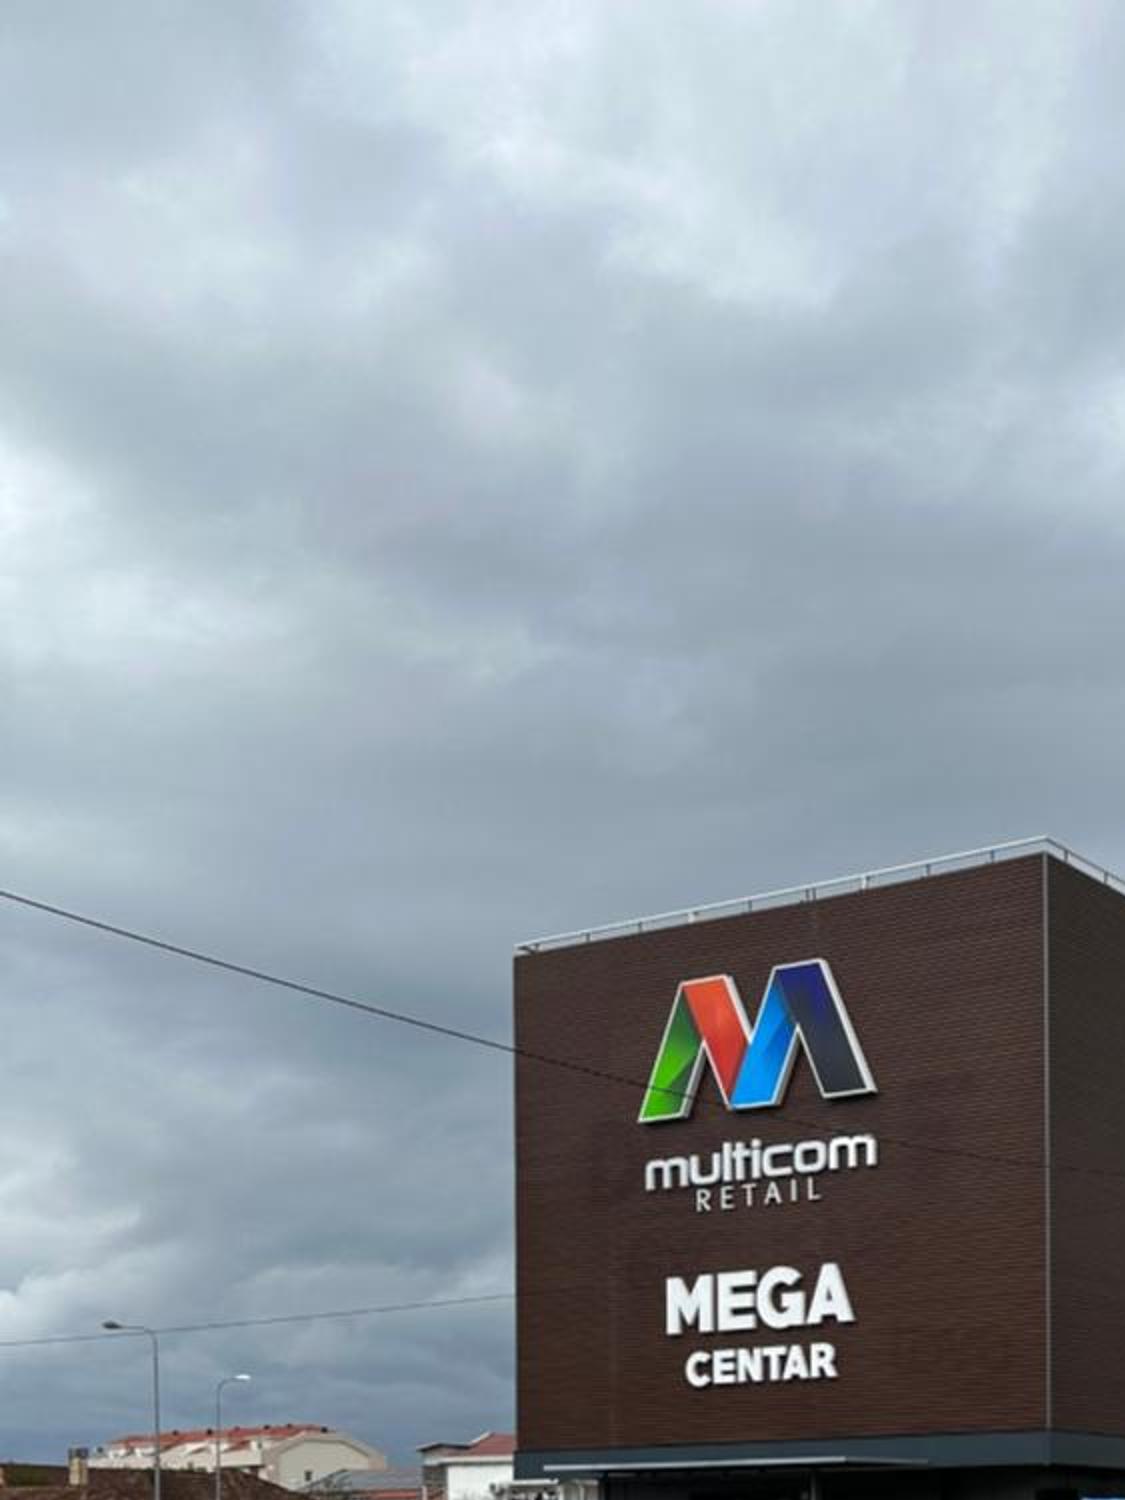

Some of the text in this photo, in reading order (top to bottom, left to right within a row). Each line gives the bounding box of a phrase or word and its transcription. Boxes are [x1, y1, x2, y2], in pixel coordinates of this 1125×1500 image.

[645, 1133, 877, 1192] multicom
[696, 1177, 822, 1213] RETAIL
[666, 1263, 855, 1336] MEGA
[686, 1343, 838, 1389] CENTAR
